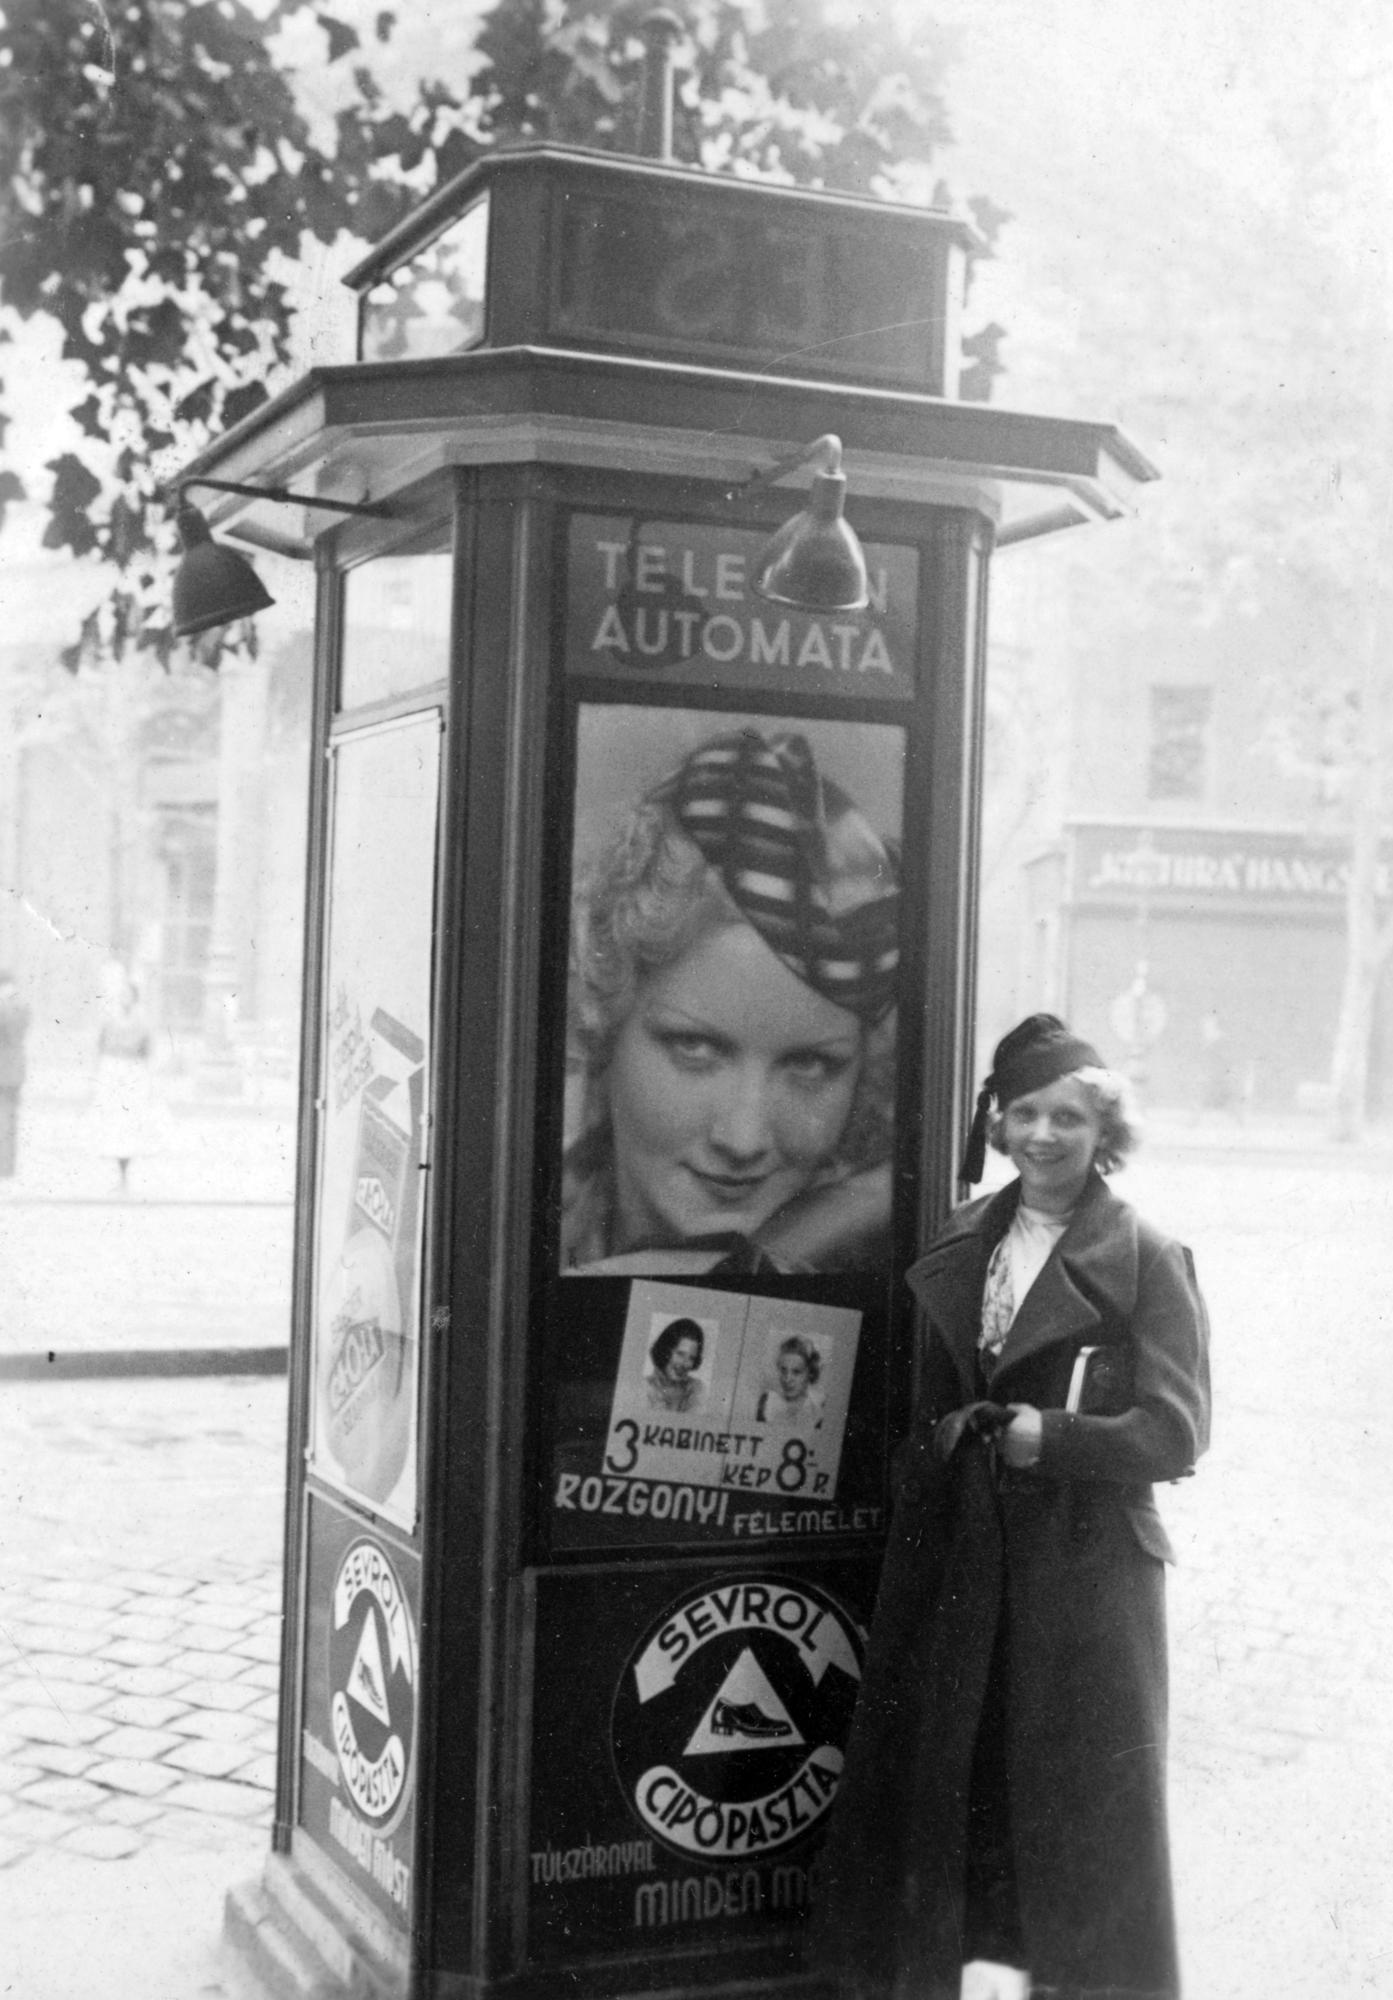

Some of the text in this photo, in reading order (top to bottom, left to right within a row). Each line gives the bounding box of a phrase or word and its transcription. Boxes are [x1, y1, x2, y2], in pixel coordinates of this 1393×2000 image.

[597, 541, 887, 613] TELEN
[591, 605, 893, 674] AUTOMATA
[606, 1419, 763, 1474] 3 KABINETT
[554, 1473, 729, 1526] ROZGONYI
[657, 1586, 829, 1663] SEVROL
[645, 1761, 840, 1849] CIPŐPASZTA
[635, 1870, 761, 1927] MINDEN
